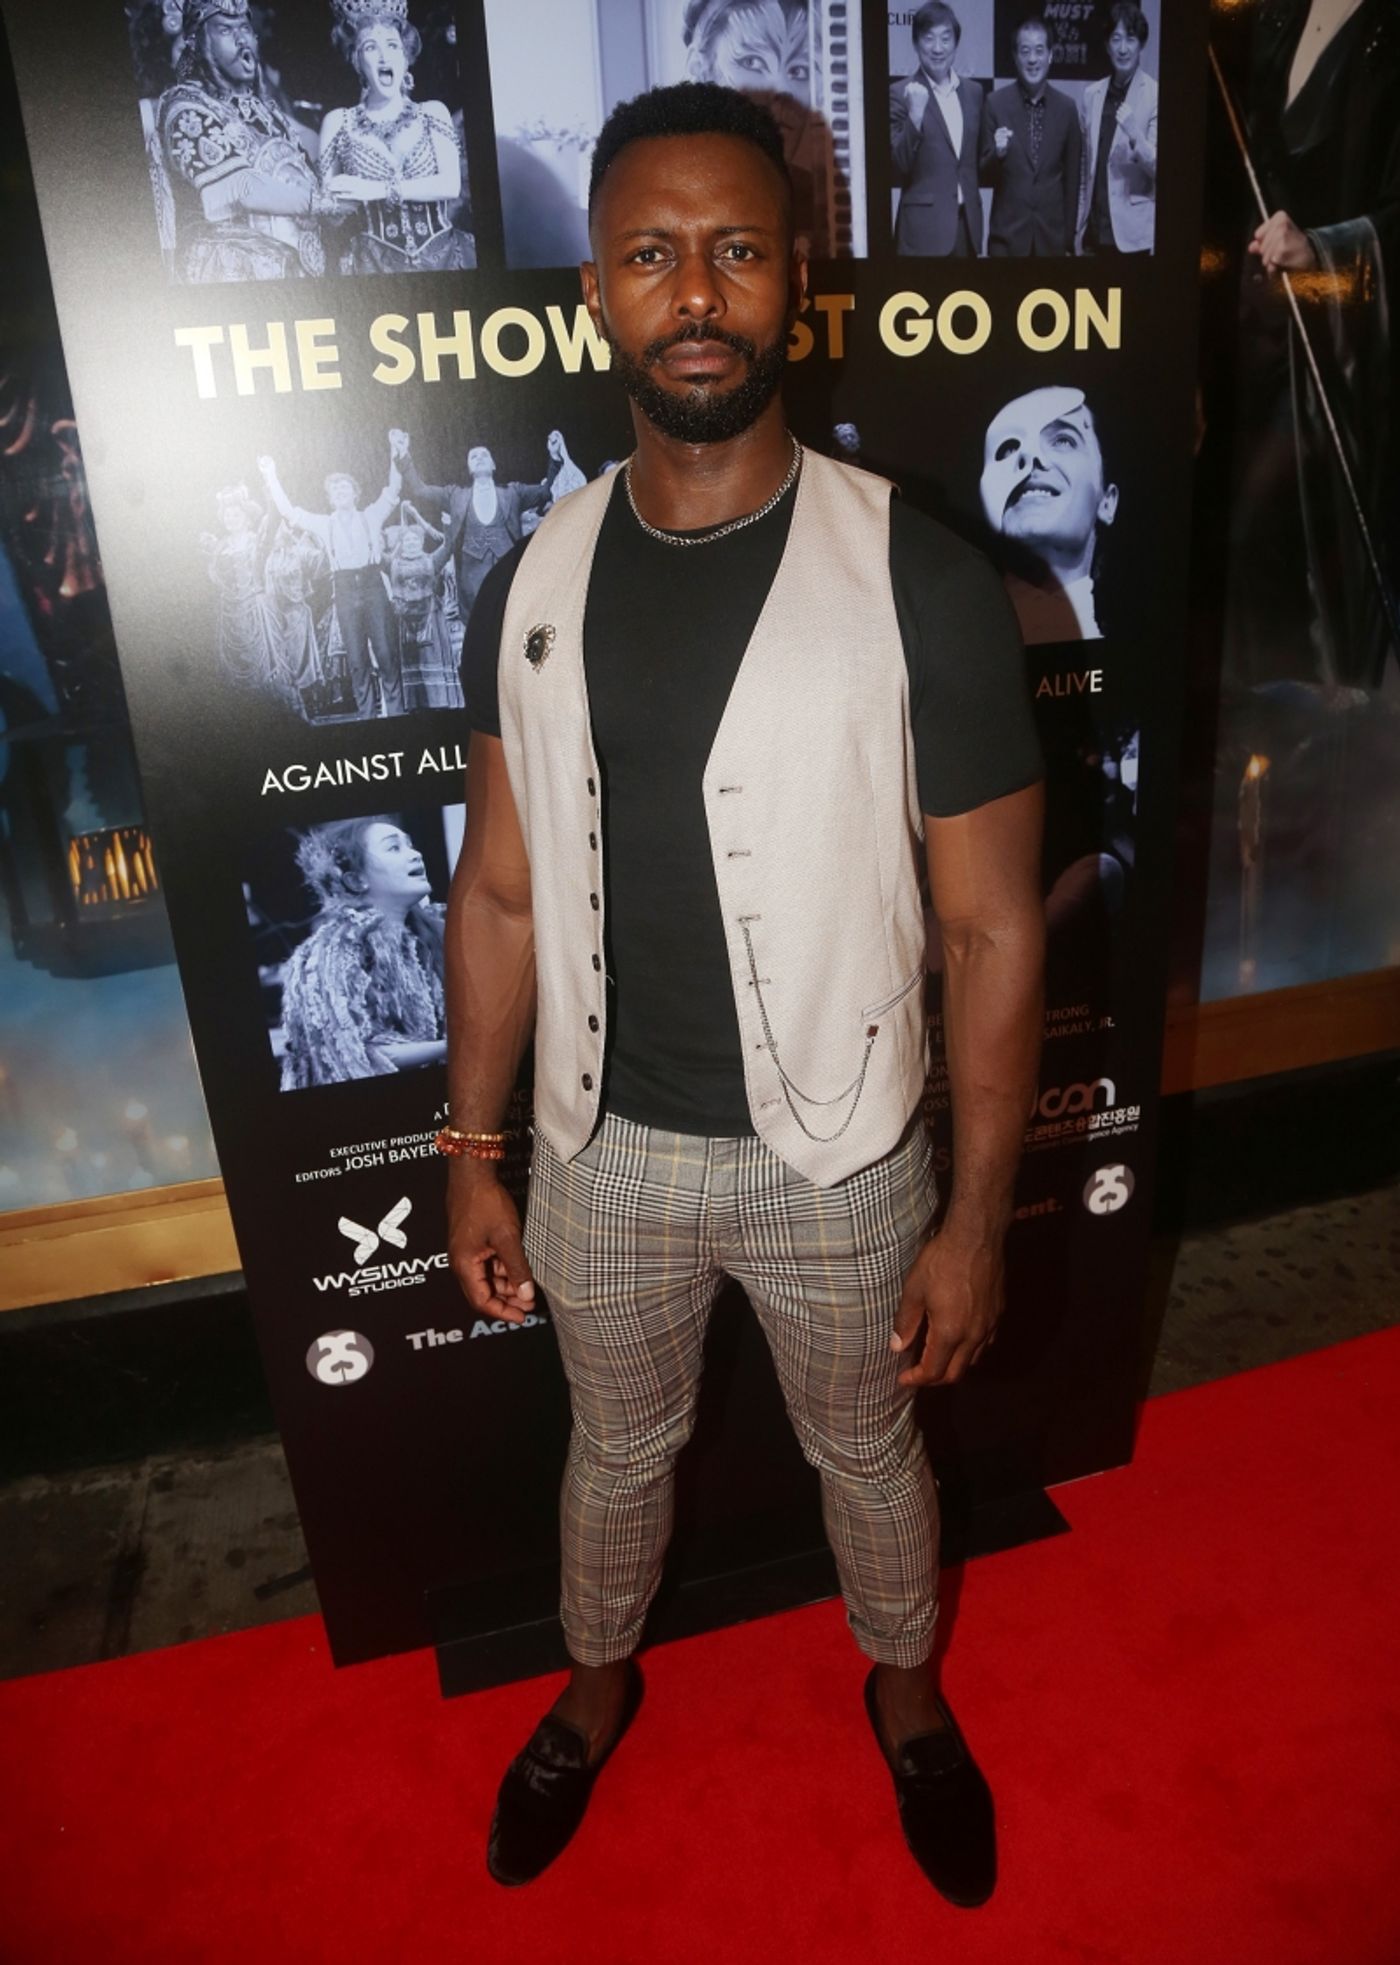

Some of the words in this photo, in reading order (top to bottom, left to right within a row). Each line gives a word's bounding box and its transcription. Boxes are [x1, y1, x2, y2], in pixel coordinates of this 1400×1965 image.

[1043, 4, 1095, 20] MUST
[174, 318, 343, 399] THE
[369, 303, 612, 386] SHOW
[785, 294, 855, 362] ST
[878, 290, 992, 357] GO
[1016, 287, 1122, 352] ON
[1035, 669, 1103, 699] ALIVE
[260, 751, 404, 796] AGAINST
[417, 744, 467, 775] ALL
[329, 1139, 388, 1158] EXECUTIVE
[295, 1166, 342, 1183] EDITORS
[344, 1152, 385, 1172] JOSH
[388, 1142, 440, 1163] BAYER
[348, 1273, 426, 1297] STUDIOS
[405, 1328, 463, 1351] The
